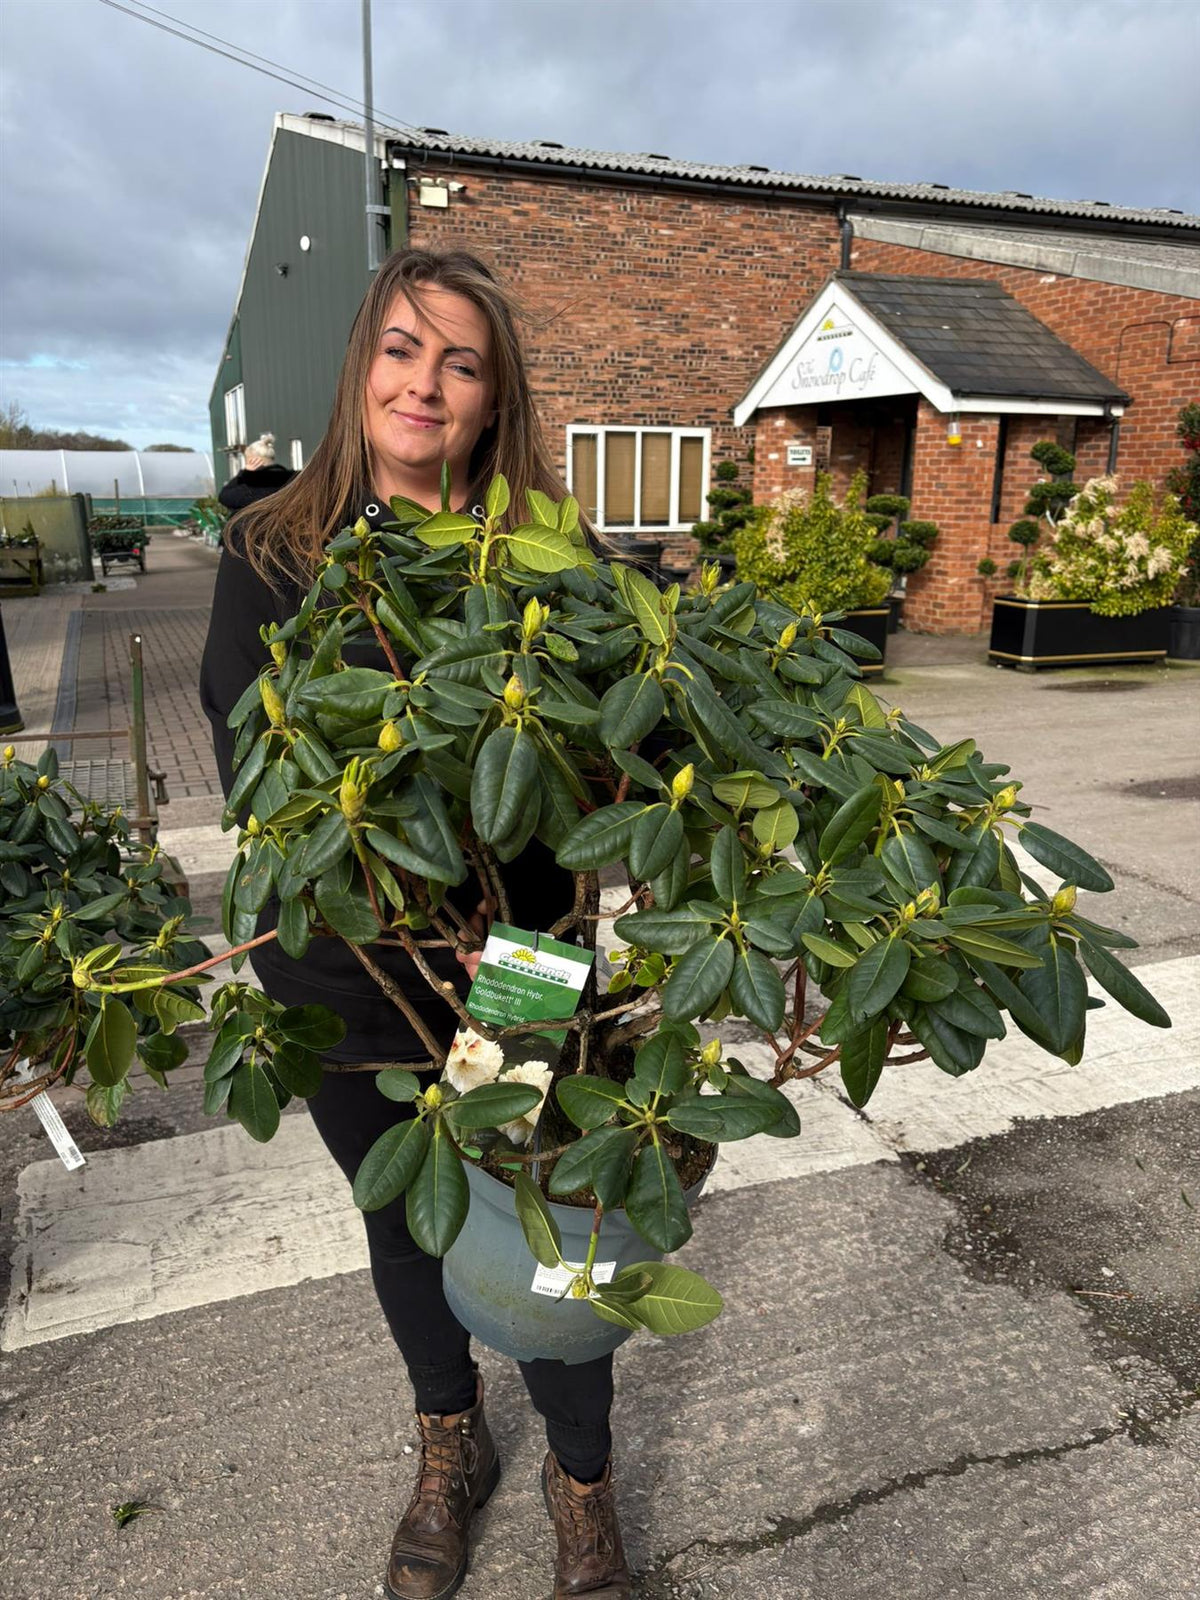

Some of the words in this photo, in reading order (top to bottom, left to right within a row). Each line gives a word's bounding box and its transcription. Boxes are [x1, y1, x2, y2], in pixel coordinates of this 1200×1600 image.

[791, 361, 846, 394] Snowdrop
[849, 352, 879, 391] Café
[499, 952, 572, 979] Grasslands
[478, 974, 526, 995] Rhododendron
[468, 1001, 507, 1018] Rhododendron
